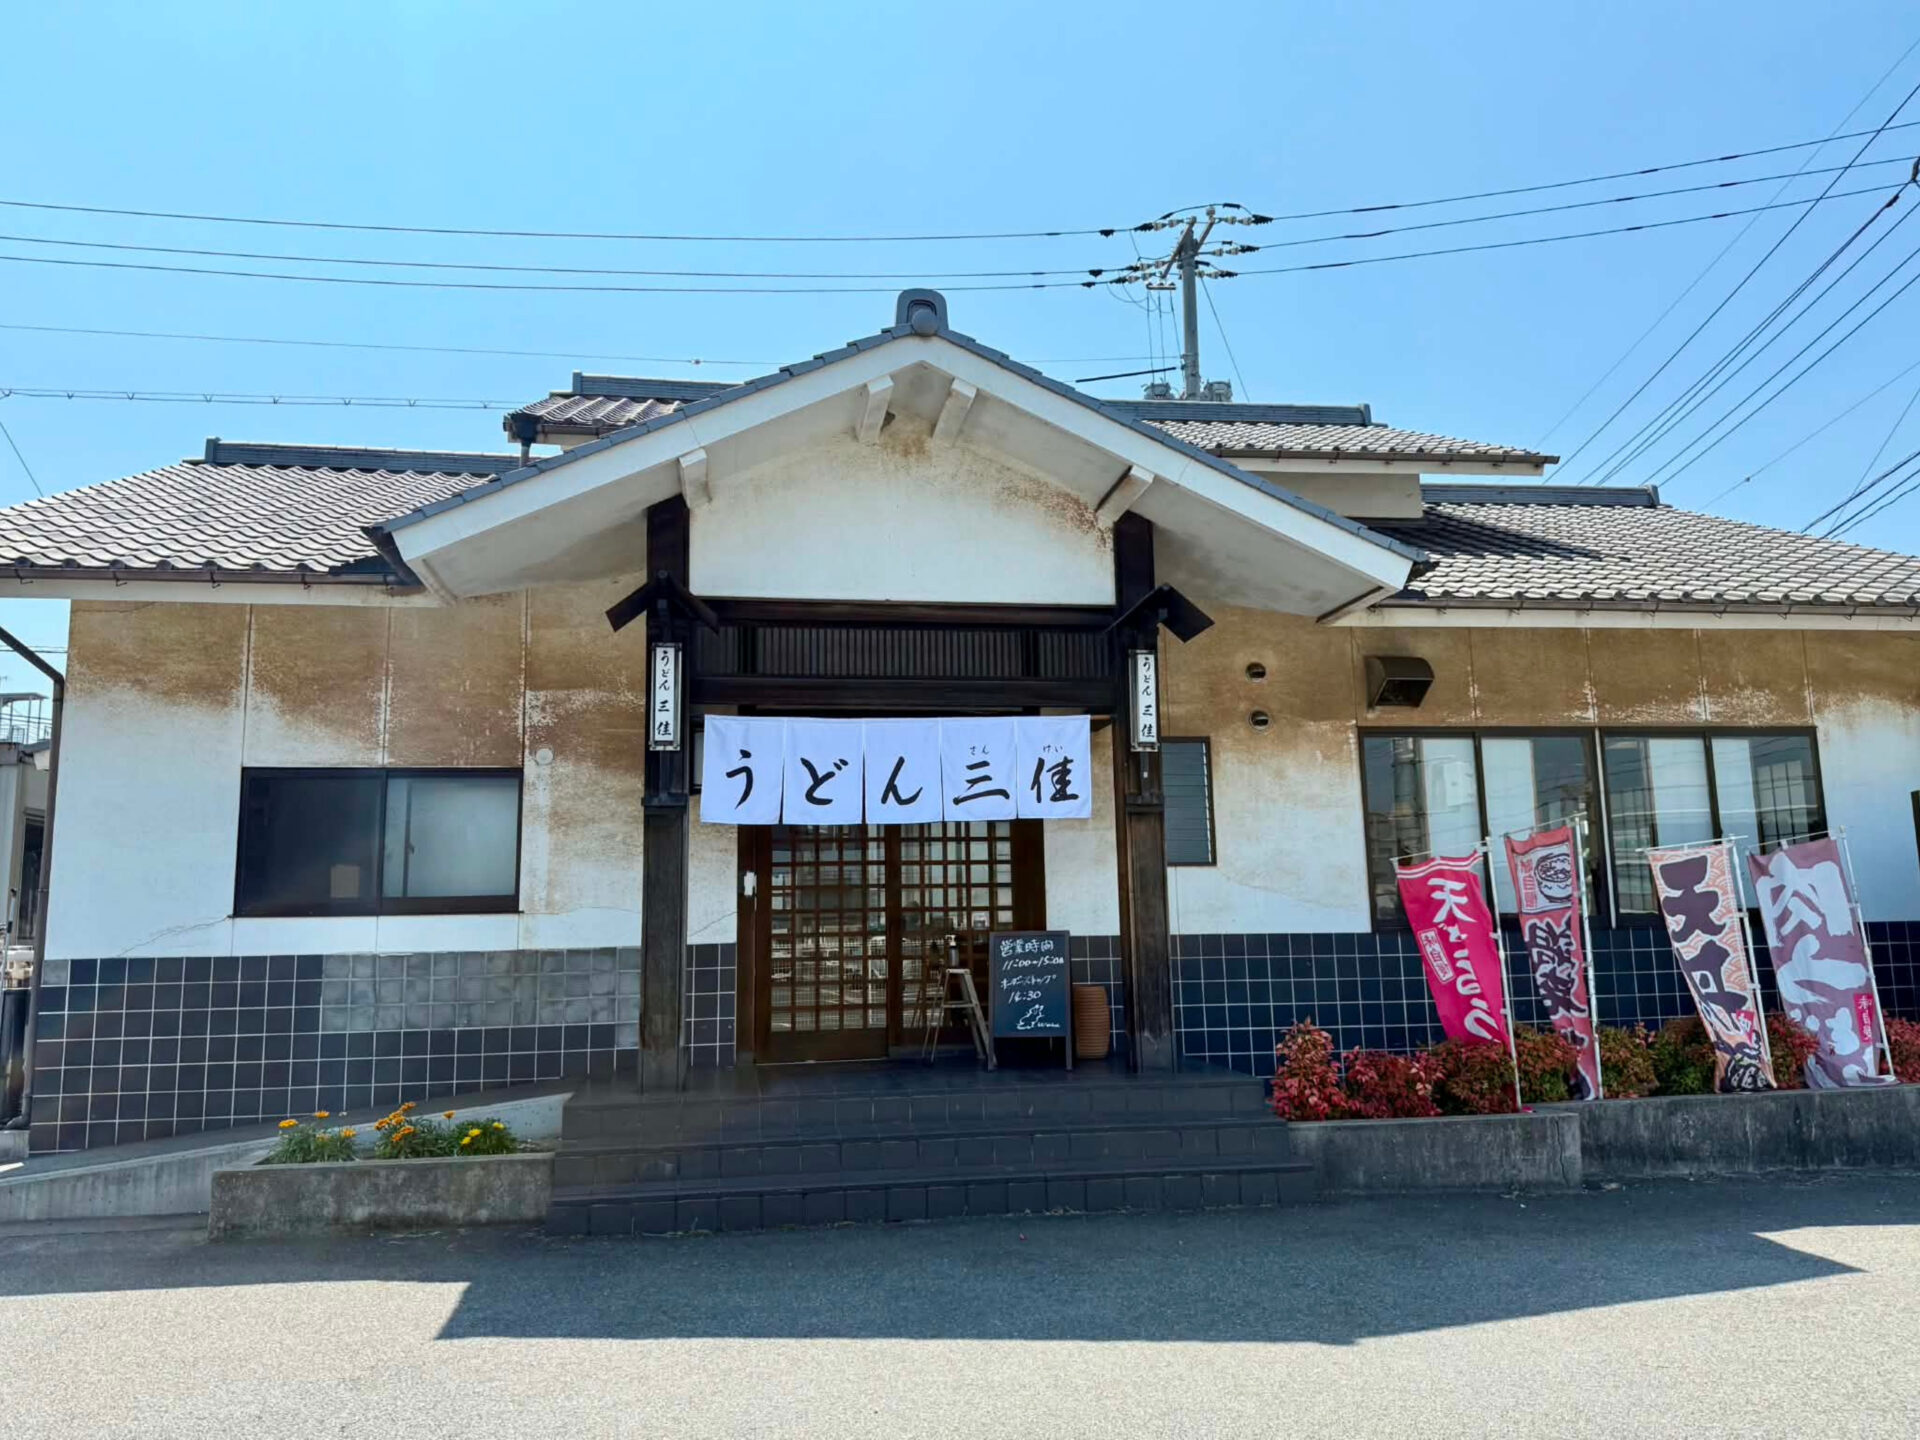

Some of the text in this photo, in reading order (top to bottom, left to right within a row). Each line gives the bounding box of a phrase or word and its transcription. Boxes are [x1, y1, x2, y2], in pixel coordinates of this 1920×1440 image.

[656, 649, 672, 736] うどん三佳
[1141, 656, 1155, 738] うどん三佳
[725, 749, 1080, 810] うどん三佳
